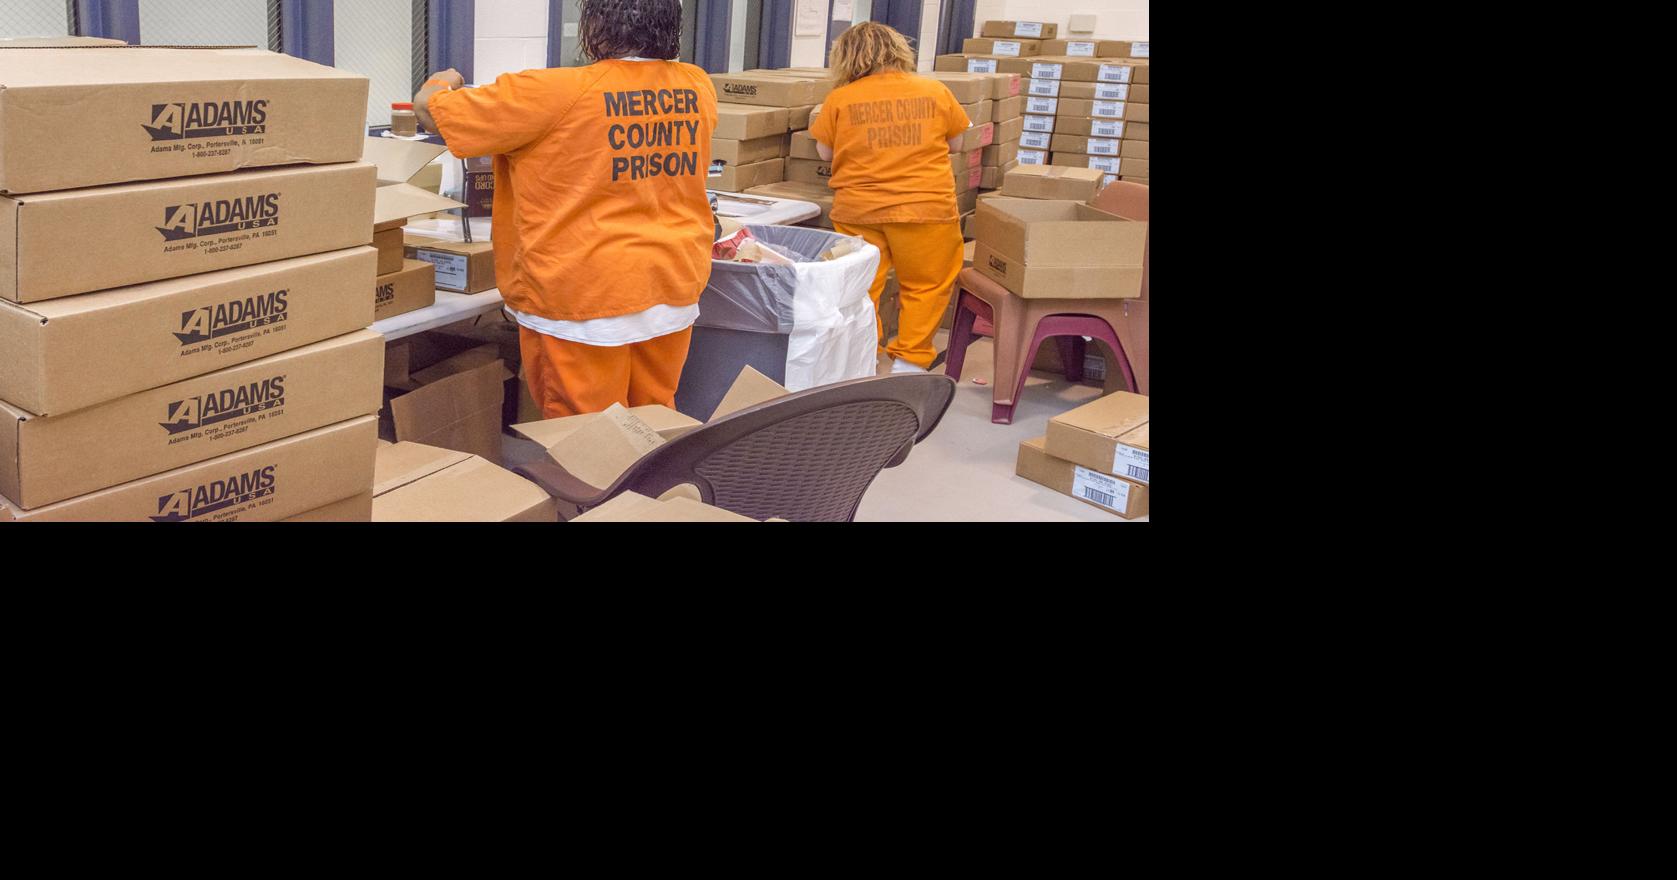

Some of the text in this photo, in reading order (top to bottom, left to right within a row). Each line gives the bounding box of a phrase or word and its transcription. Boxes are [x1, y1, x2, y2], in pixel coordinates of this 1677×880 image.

[185, 100, 267, 128] ADAMS
[603, 89, 699, 117] MERCER
[848, 96, 937, 126] MERCER COUNTY
[150, 145, 172, 153] Adams
[608, 120, 699, 150] COUNTY
[867, 123, 921, 149] PRISON
[612, 152, 698, 182] PRISON
[198, 192, 278, 227] ADAMS
[164, 245, 185, 253] Adams
[213, 289, 288, 329] ADAMS
[180, 347, 200, 356] Adams
[202, 376, 285, 417] ADAMS
[168, 435, 189, 445] Adams
[192, 465, 275, 509] ADAMS
